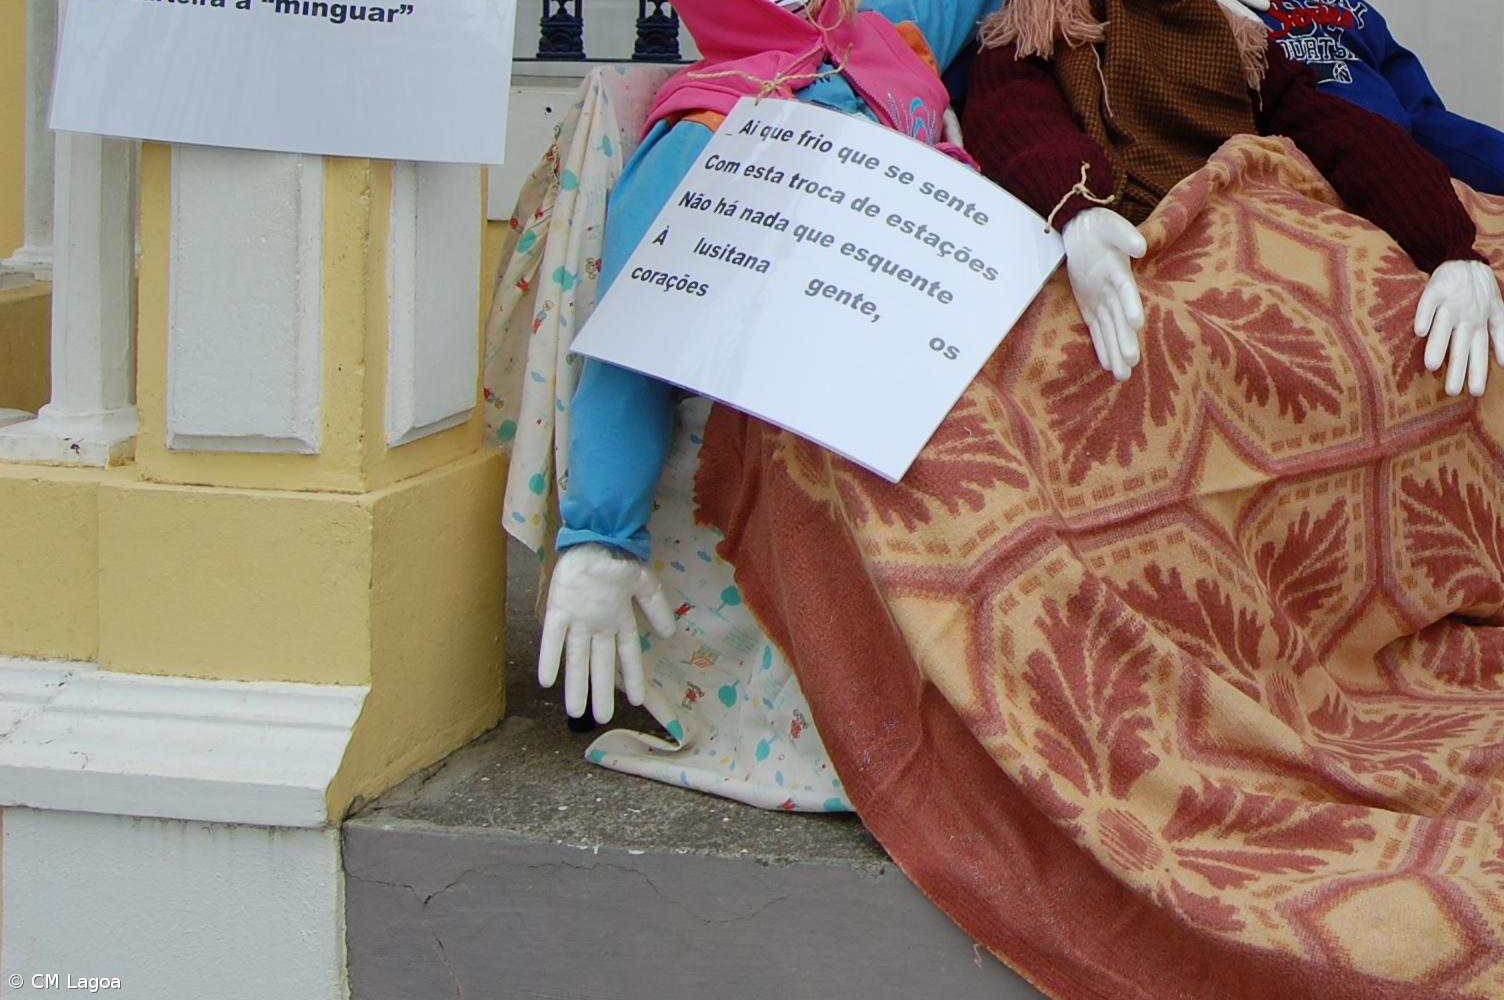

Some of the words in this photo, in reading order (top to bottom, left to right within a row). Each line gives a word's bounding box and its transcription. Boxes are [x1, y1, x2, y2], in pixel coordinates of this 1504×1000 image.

[704, 153, 742, 175] Com
[743, 164, 785, 185] esta
[787, 172, 846, 205] troca
[850, 196, 881, 218] de
[885, 213, 999, 281] estações
[738, 119, 761, 136] Ai
[759, 125, 795, 143] que
[796, 129, 834, 153] frio
[837, 146, 881, 170] que
[883, 165, 915, 185] se
[918, 181, 989, 226] sente
[630, 266, 710, 297] corações
[677, 190, 713, 212] Não
[712, 196, 740, 217] há
[738, 207, 790, 233] nada
[793, 224, 835, 248] que
[839, 242, 954, 305] esquente
[692, 236, 771, 274] lusitana
[804, 278, 881, 324] gente,
[928, 337, 961, 361] os
